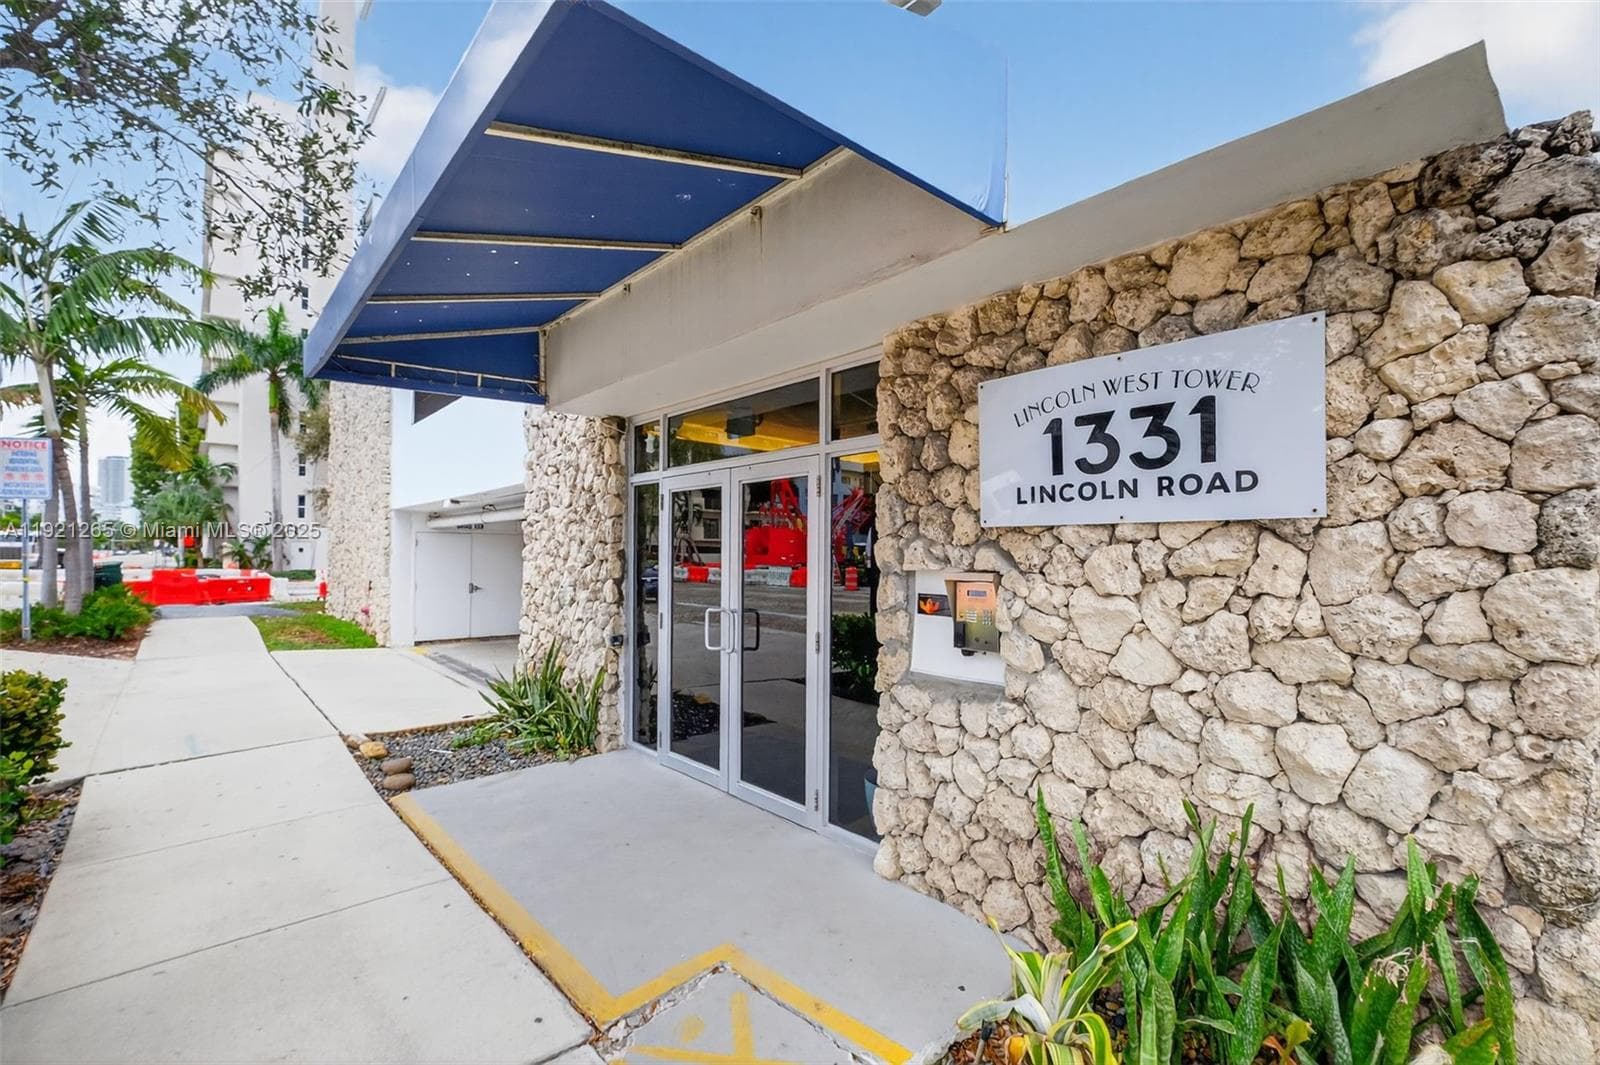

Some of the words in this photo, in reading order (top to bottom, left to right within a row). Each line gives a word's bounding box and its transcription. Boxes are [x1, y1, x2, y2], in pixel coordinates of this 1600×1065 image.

[1013, 382, 1097, 427] LINCOLN
[1103, 371, 1163, 397] WEST
[1172, 368, 1262, 394] TOWER
[1, 440, 47, 450] NOTICE
[1042, 395, 1217, 476] 1331
[1016, 478, 1139, 505] LINCOLN
[1157, 470, 1259, 497] ROAD
